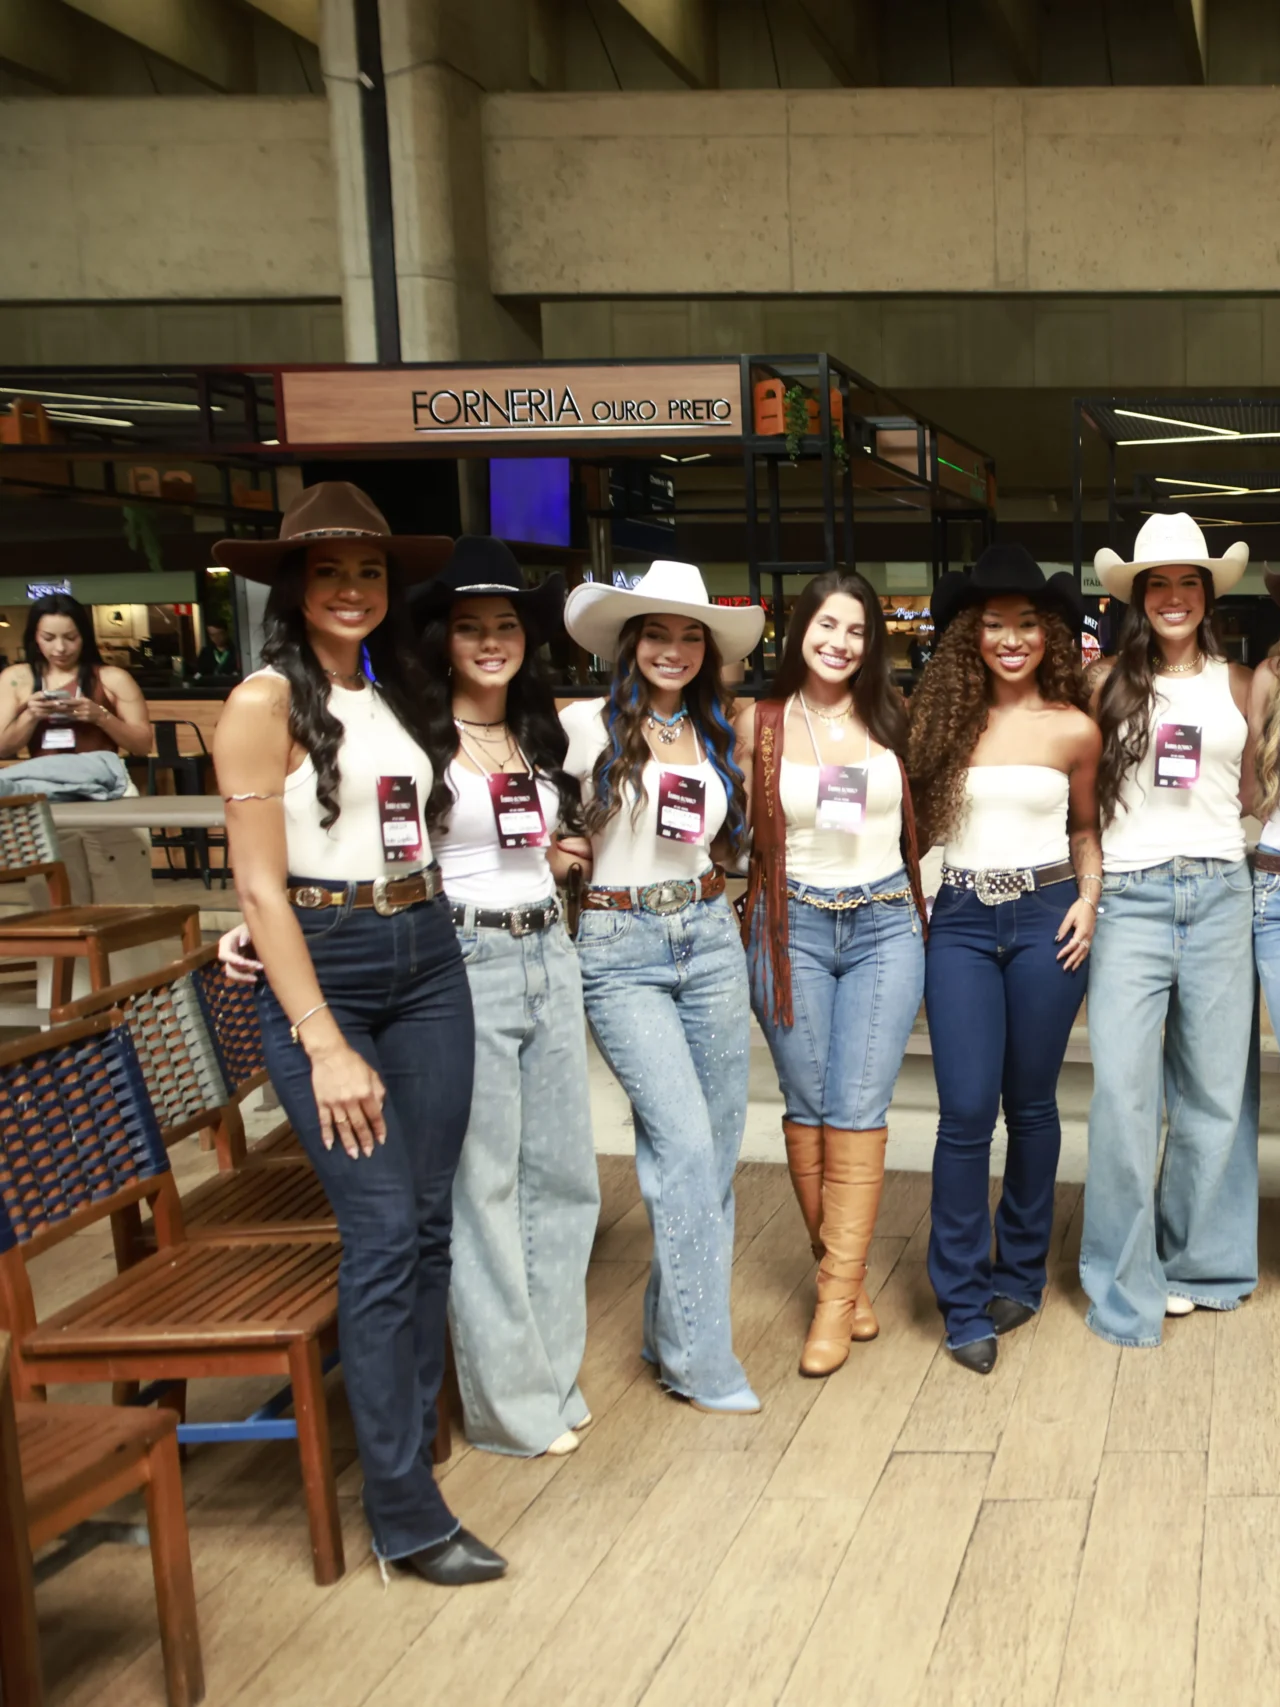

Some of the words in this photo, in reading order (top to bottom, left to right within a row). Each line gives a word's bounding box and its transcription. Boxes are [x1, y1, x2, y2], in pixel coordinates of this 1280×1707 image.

[411, 385, 584, 426] FORNERIA
[591, 399, 658, 423] OURO
[667, 398, 732, 421] PRETO
